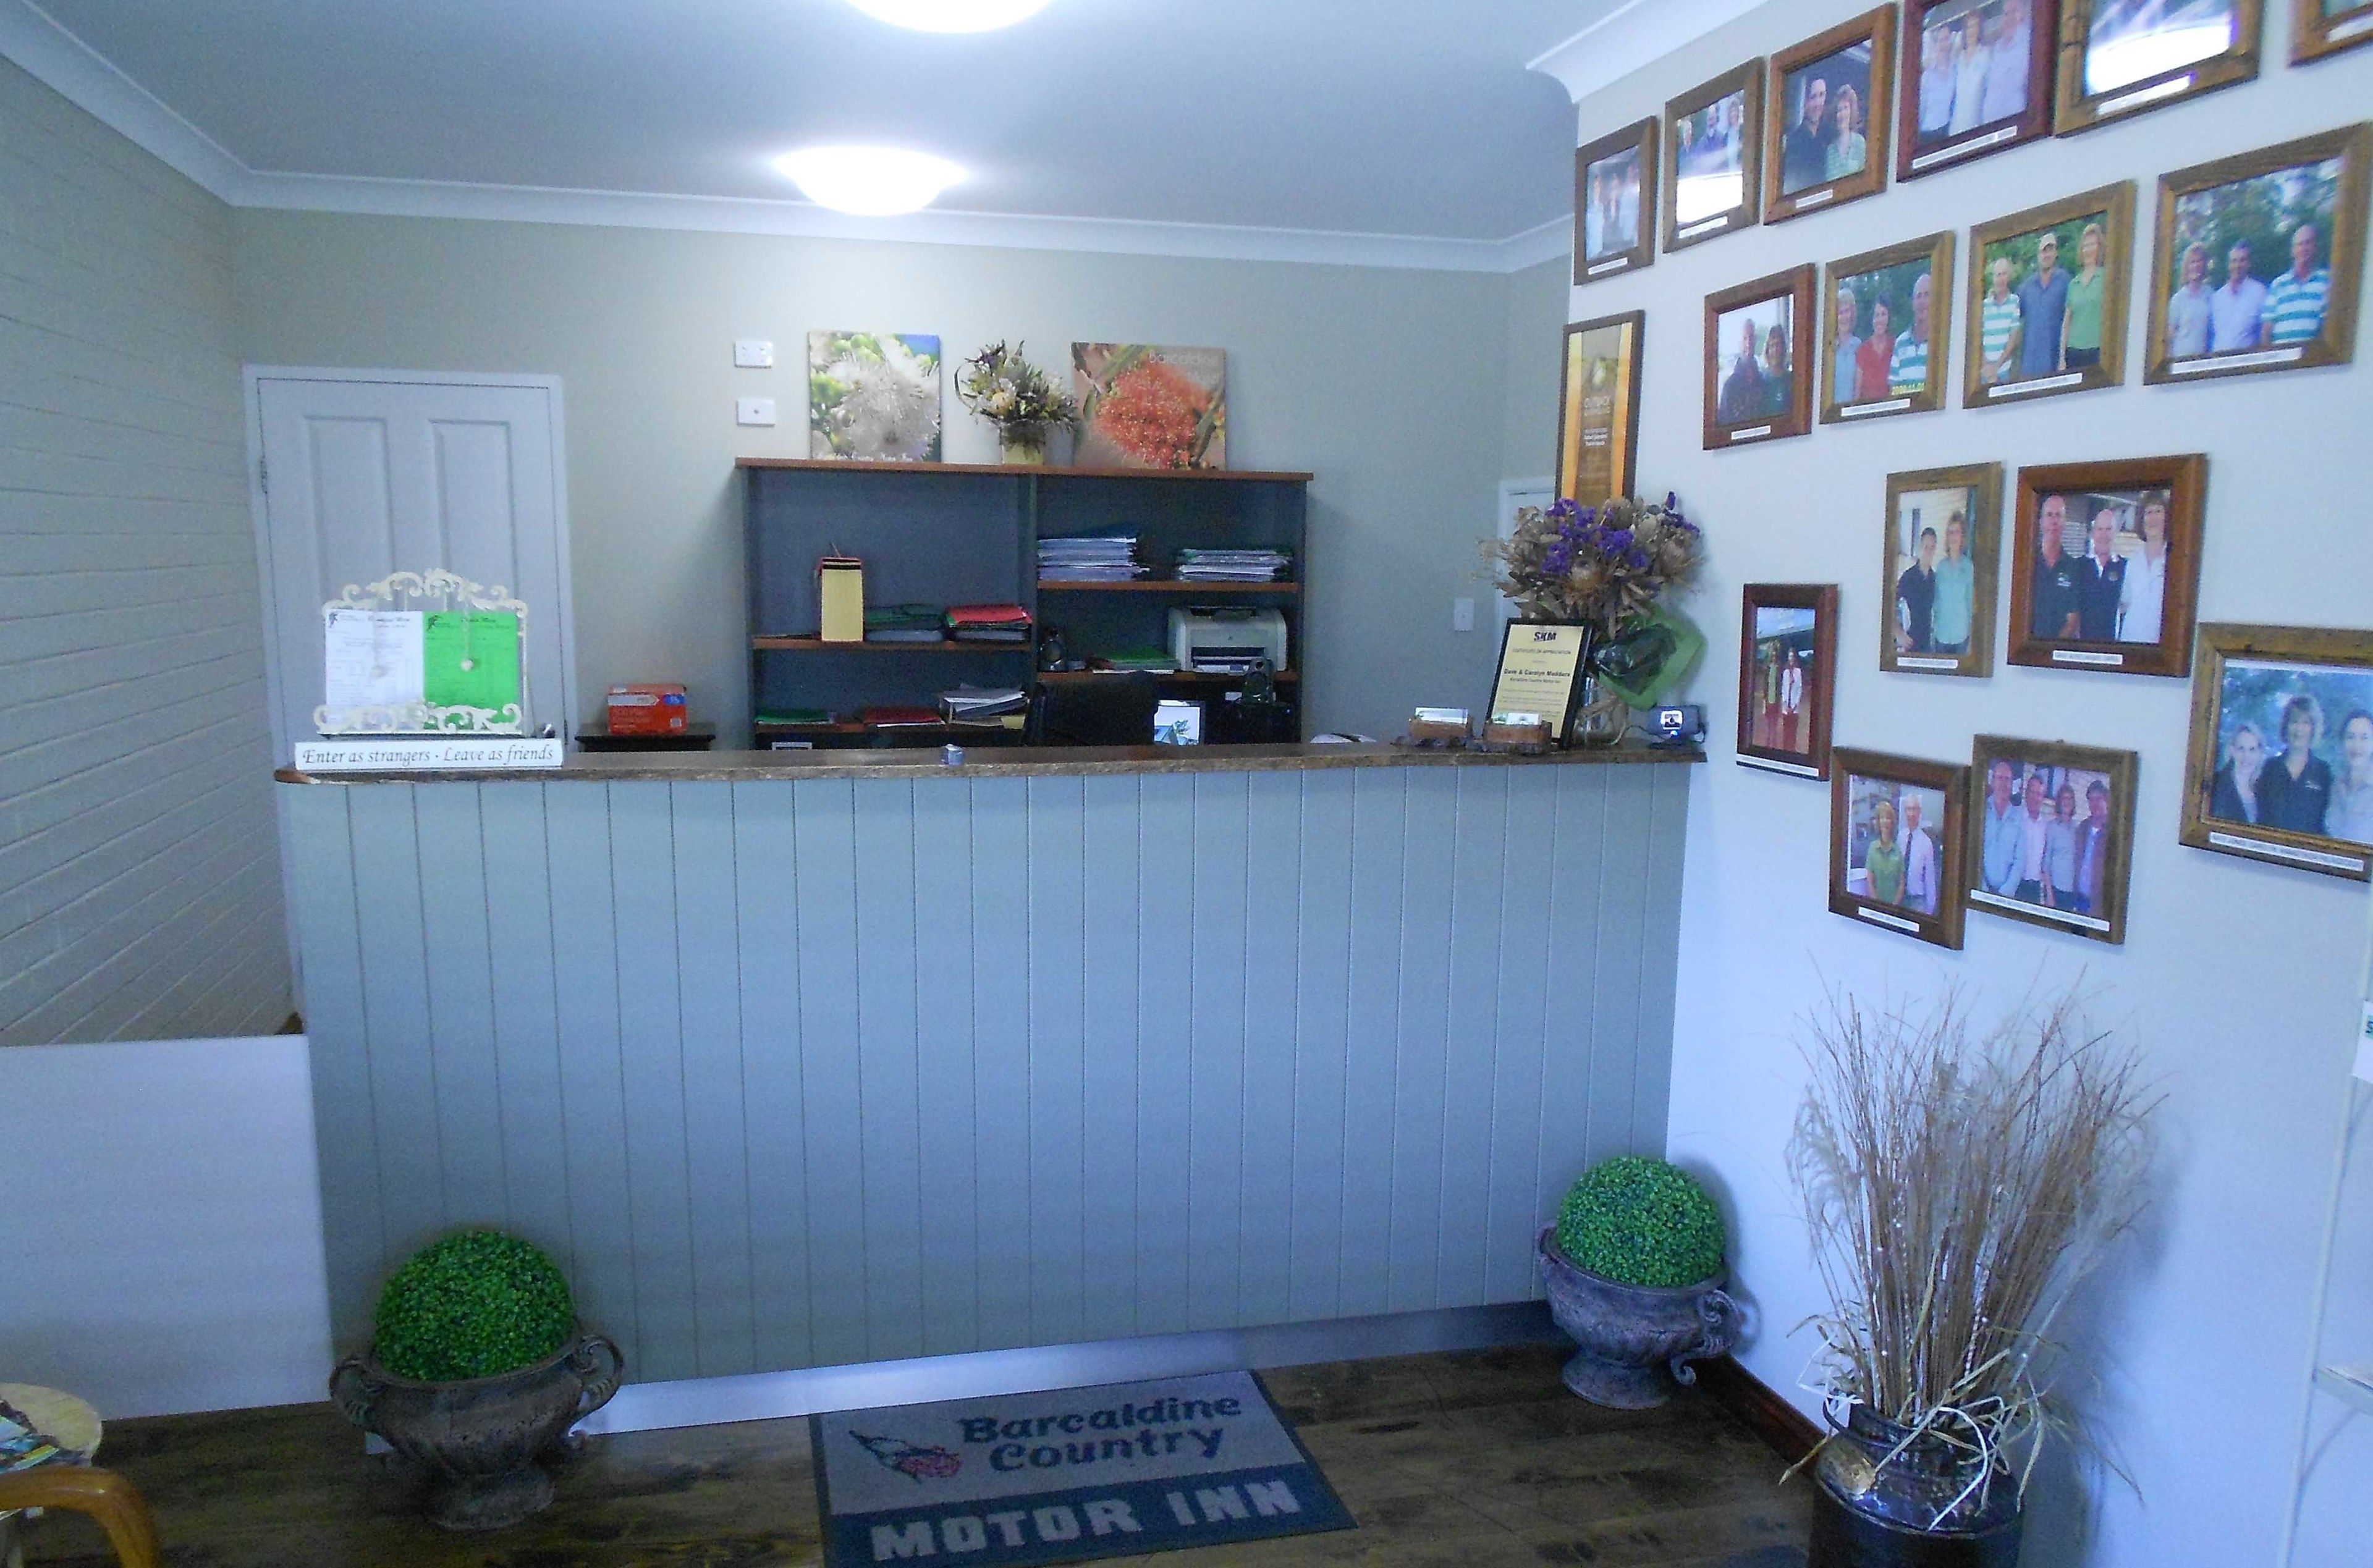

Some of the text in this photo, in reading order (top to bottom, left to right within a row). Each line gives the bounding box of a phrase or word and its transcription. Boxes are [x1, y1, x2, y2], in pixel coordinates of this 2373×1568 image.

[303, 744, 554, 767] Enter as strangers Leave as friends
[961, 1397, 1241, 1444] Barcaldine
[990, 1427, 1224, 1472] Country
[872, 1480, 1300, 1561] MOTOR INN
